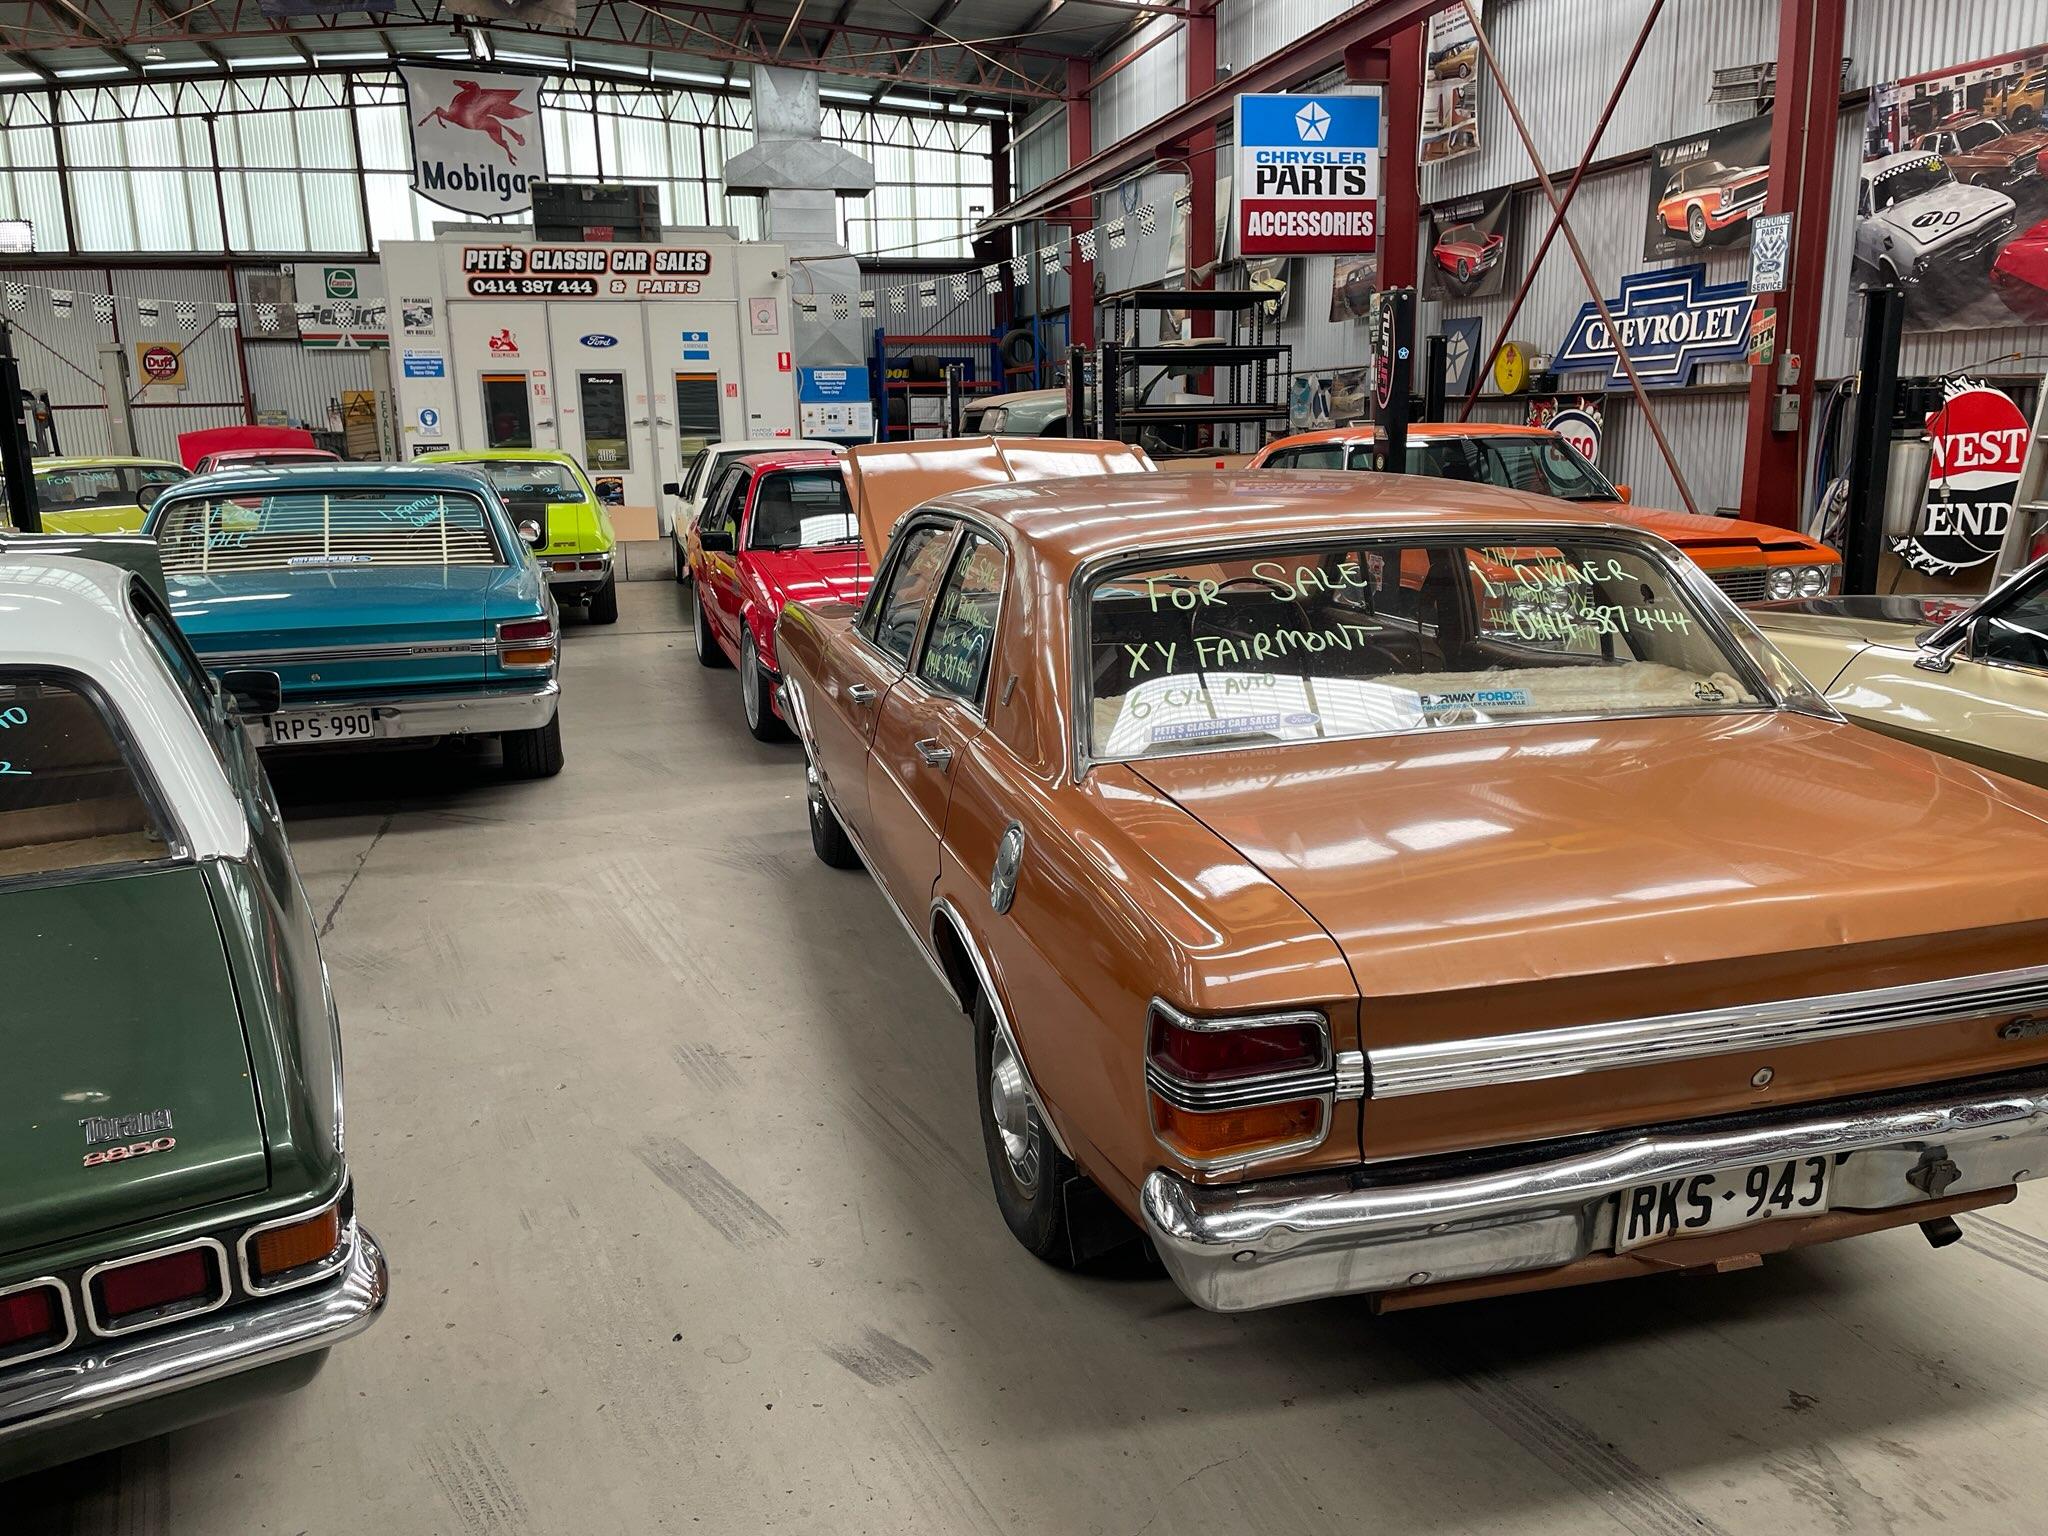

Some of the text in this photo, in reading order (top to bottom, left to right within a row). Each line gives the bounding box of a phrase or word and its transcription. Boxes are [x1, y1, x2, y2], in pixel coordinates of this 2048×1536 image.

[1256, 151, 1366, 164] CHRYSLER
[1675, 139, 1711, 157] HATCH
[1256, 165, 1366, 195] PARTS
[1248, 211, 1374, 237] ACCESSORIES
[1755, 214, 1790, 229] GENUINE
[1761, 226, 1784, 236] PARTS
[465, 246, 708, 272] PETE'S CLASSIC CAR SALES
[1759, 262, 1778, 272] Ford
[331, 279, 353, 288] Castrol
[473, 279, 700, 294] 0414 387 444 & PARTS
[1751, 280, 1783, 292] SERVICE
[1585, 304, 1740, 350] CHEVROLET
[1749, 326, 1775, 350] GTX
[587, 334, 611, 346] Ford
[147, 356, 174, 368] Duff
[394, 494, 439, 519] FAMILY
[1923, 502, 2014, 536] END
[1146, 572, 1228, 612] FOR
[1252, 562, 1368, 602] SALE
[1513, 558, 1639, 593] OWNER
[1513, 606, 1577, 641] 0414
[1578, 605, 1632, 635] 387
[1633, 607, 1692, 636] 444
[1124, 622, 1384, 679] XY FAIRMONT
[1129, 673, 1277, 720] 6 CYL AUTO
[1420, 691, 1513, 706] FRWAY FORD
[1154, 724, 1185, 737] PETE'S
[1187, 719, 1226, 734] CLASSIC
[1249, 714, 1278, 726] SALES
[1290, 715, 1313, 724] Ford
[79, 1109, 173, 1145] Torana
[83, 1137, 177, 1167] 2850
